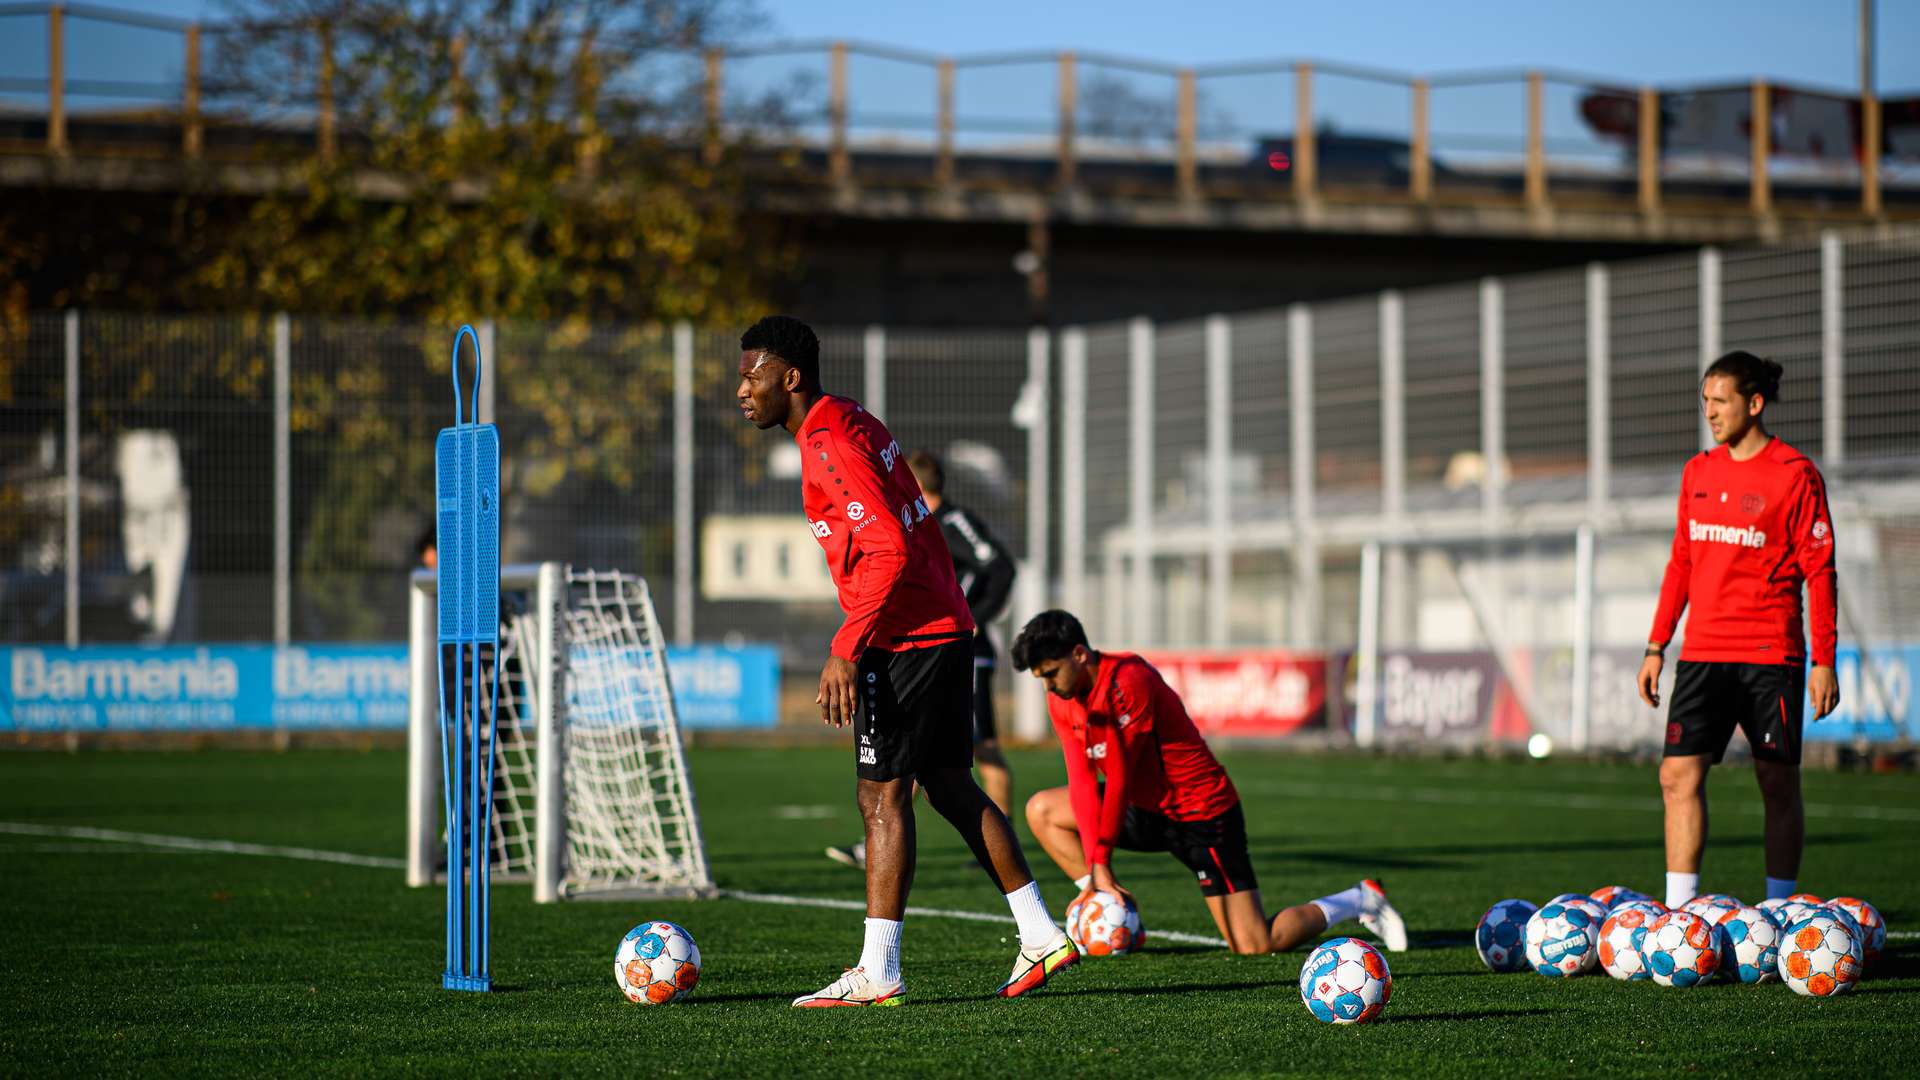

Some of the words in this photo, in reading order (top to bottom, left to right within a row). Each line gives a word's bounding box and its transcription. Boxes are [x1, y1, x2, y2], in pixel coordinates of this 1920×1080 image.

[1689, 518, 1766, 548] Barmenia
[12, 647, 238, 700] Barmenia
[1384, 656, 1482, 738] Bayer
[860, 734, 871, 745] XL
